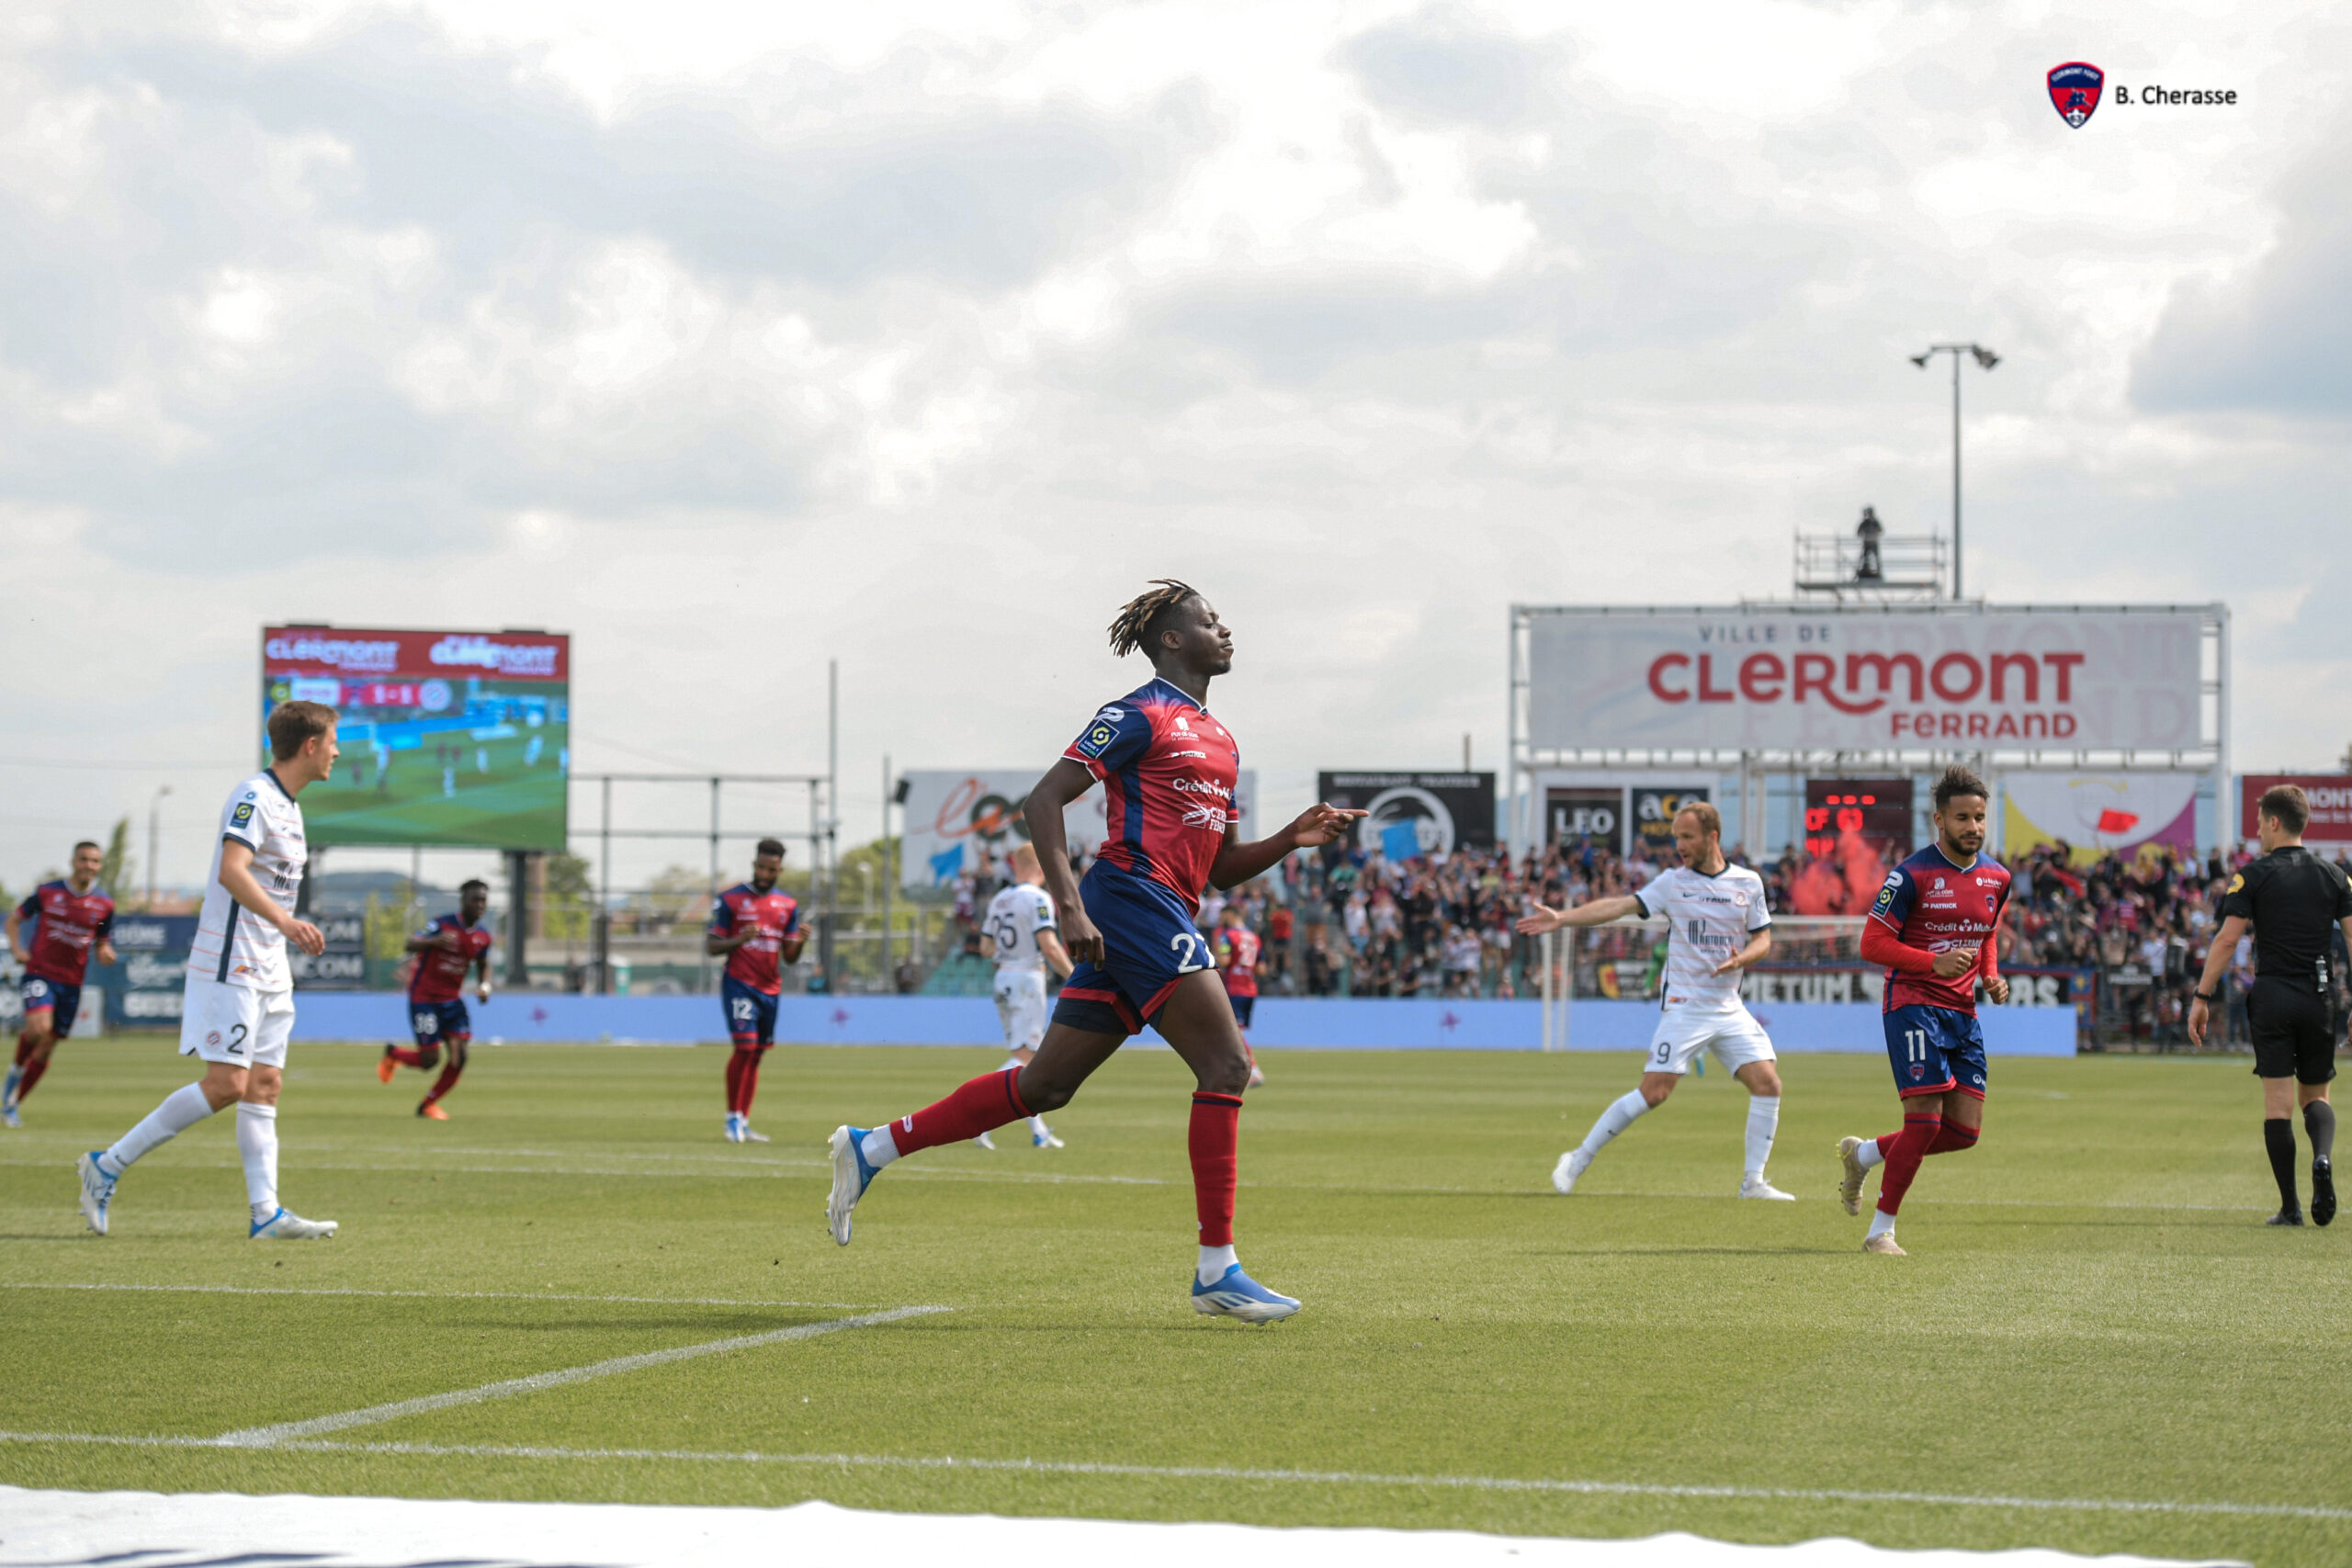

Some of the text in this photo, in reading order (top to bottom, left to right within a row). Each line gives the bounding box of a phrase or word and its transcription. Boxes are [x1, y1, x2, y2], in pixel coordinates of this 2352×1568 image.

[1701, 626, 1831, 642] VILLE DE
[1925, 921, 1957, 931] Crédit
[731, 998, 752, 1021] 12
[227, 1024, 247, 1055] 2
[1905, 1030, 1926, 1062] 11
[1657, 1042, 1671, 1065] 9
